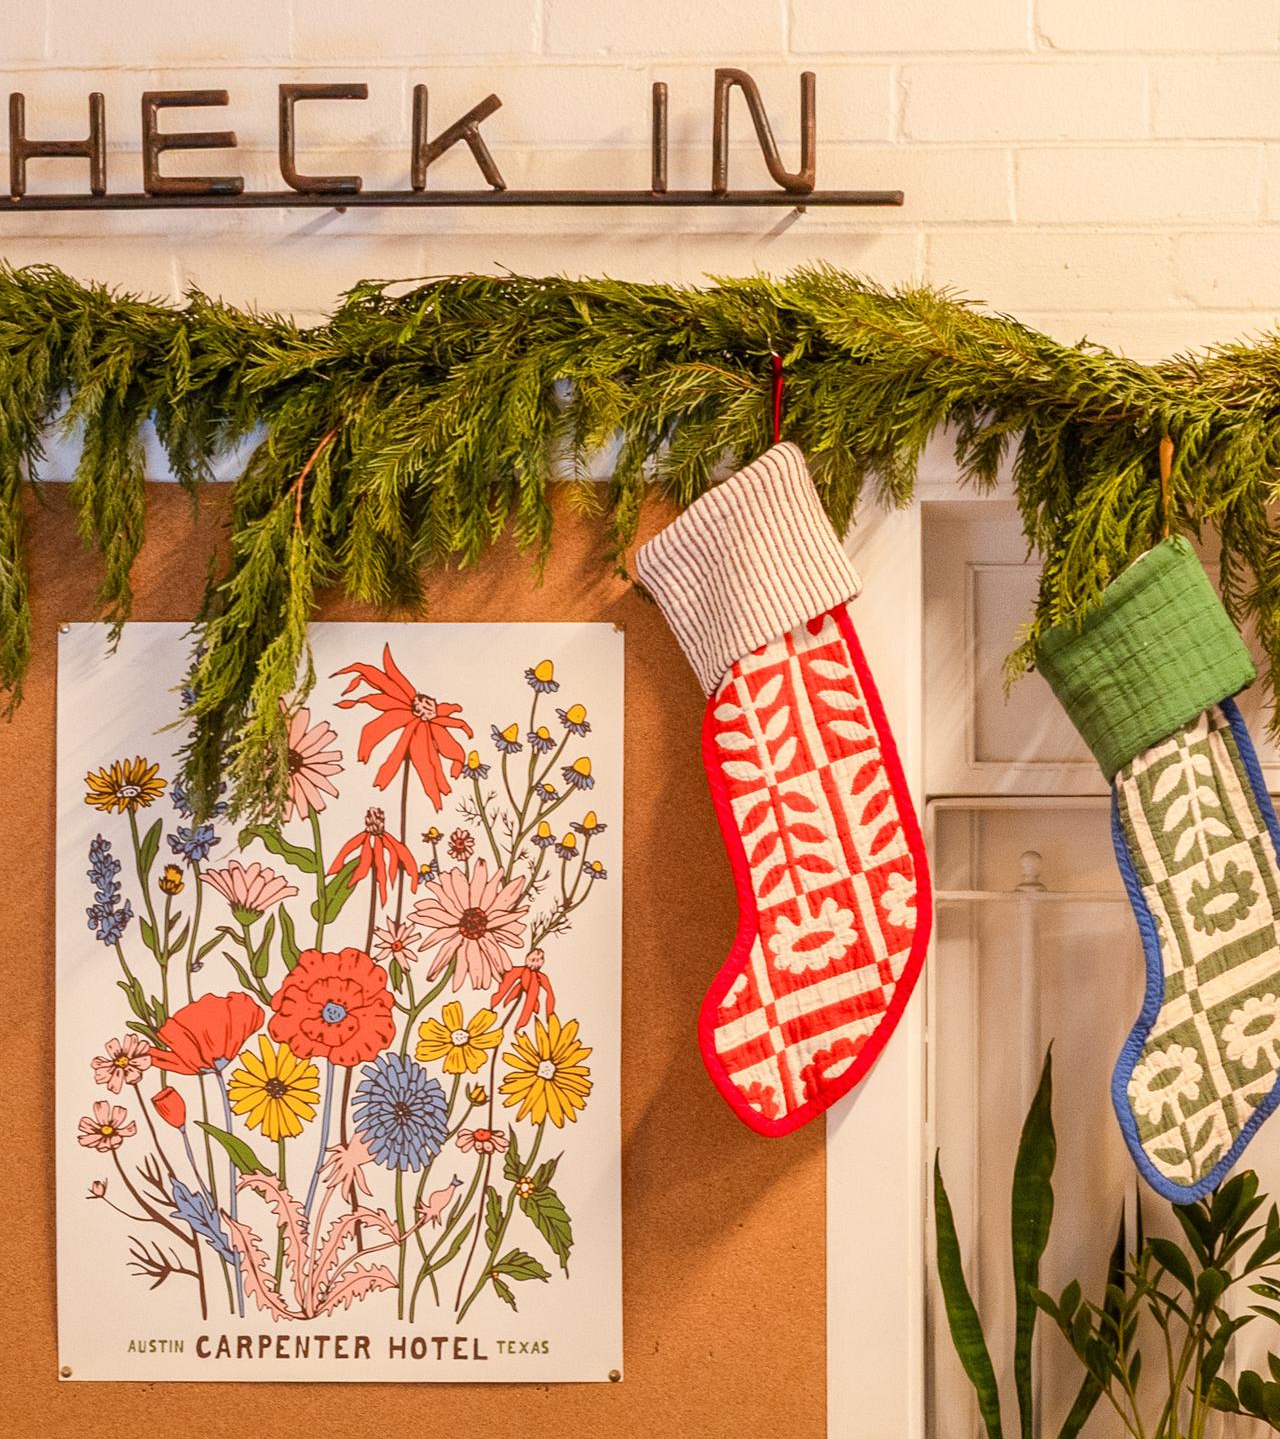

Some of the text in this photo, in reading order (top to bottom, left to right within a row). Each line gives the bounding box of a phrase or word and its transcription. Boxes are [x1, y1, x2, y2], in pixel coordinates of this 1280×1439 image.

[651, 67, 816, 195] IN
[127, 1334, 550, 1361] AUSTIN CARPENTER HOTEL TEXAS
